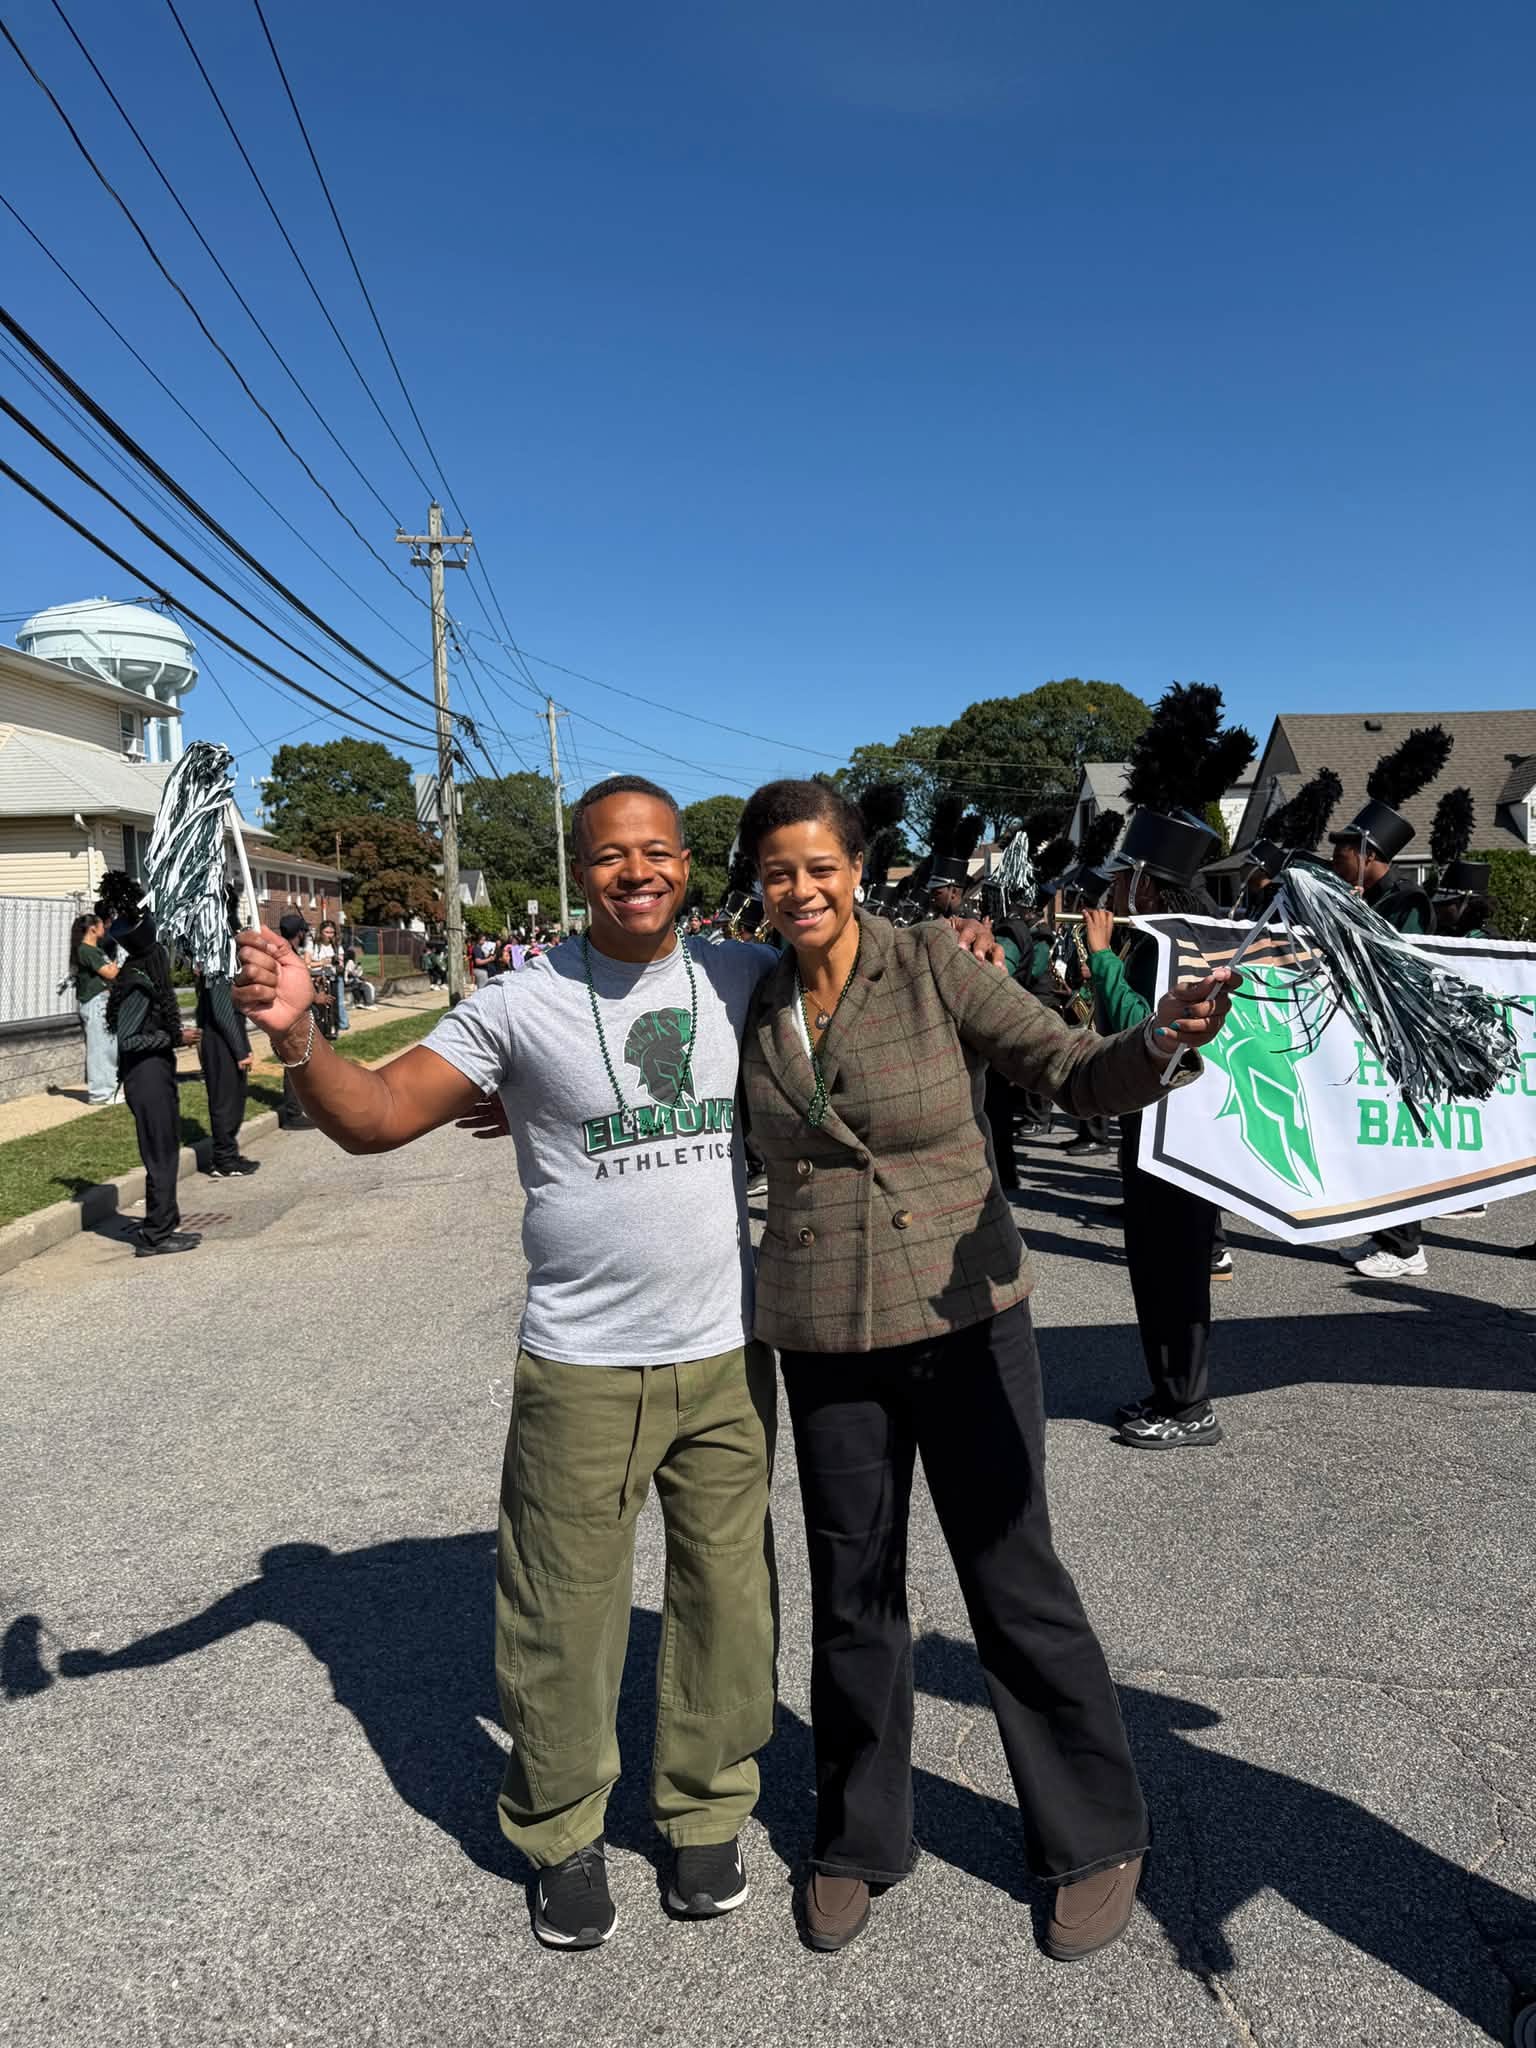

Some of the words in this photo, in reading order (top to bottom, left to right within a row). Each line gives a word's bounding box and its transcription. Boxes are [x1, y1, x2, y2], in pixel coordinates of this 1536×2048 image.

[582, 1098, 733, 1156] ELMONT
[1357, 1098, 1483, 1151] BAND
[595, 1143, 733, 1180] ATHLETICS
